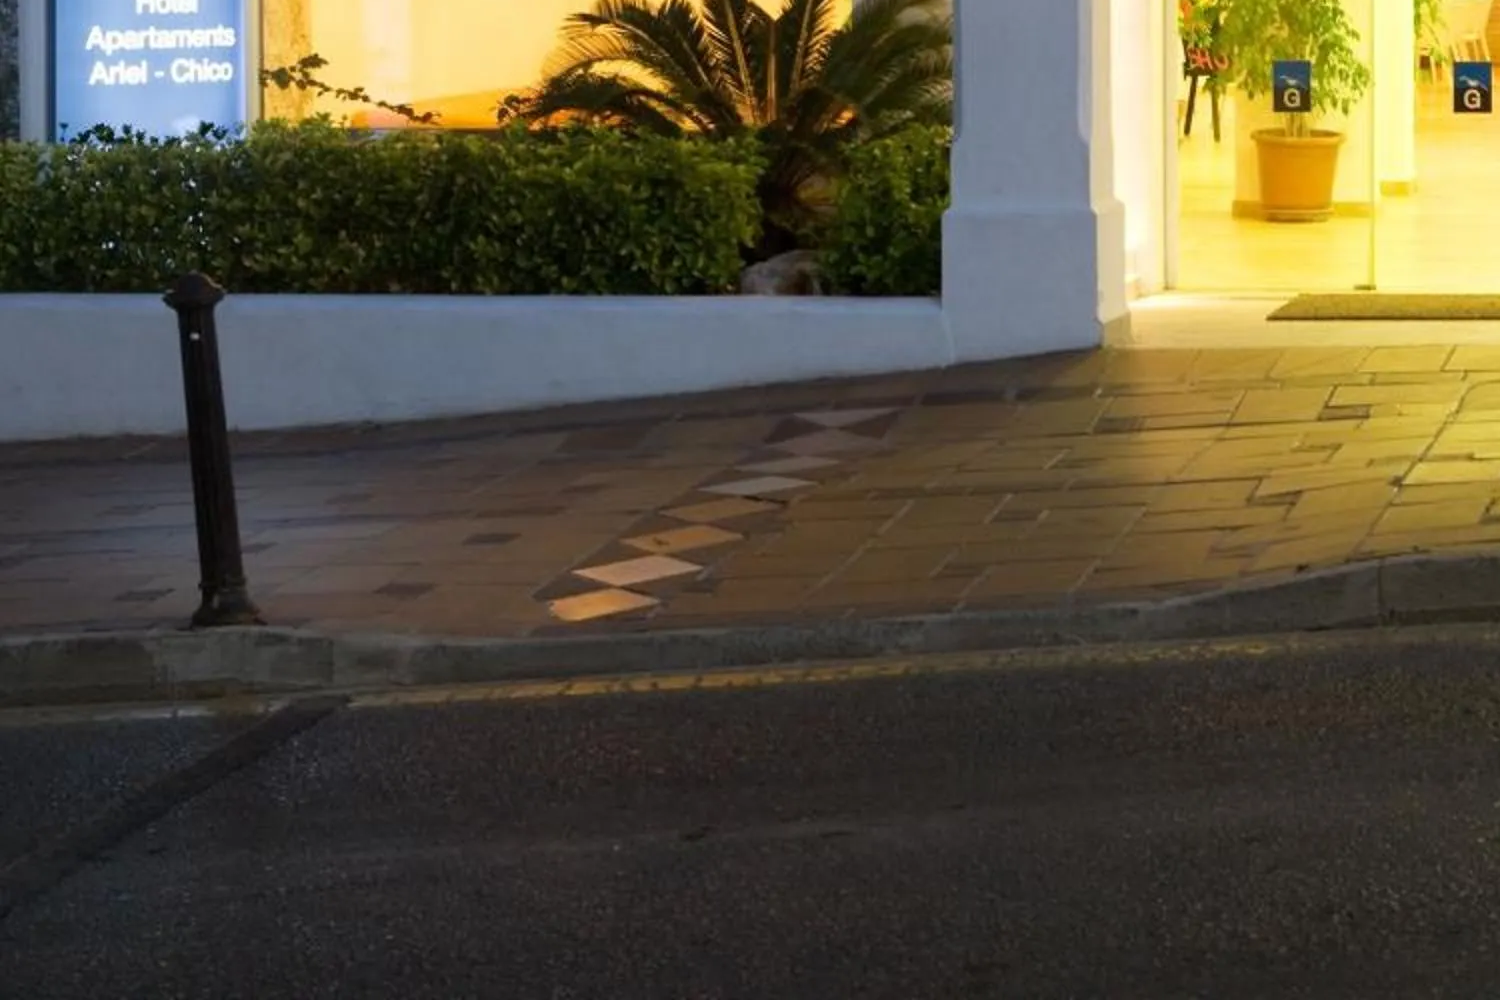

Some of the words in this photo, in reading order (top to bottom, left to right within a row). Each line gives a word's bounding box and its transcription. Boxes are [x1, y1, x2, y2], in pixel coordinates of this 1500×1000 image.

[85, 24, 236, 56] Apartaments
[88, 60, 148, 86] Ariel
[170, 57, 234, 84] Chico
[1283, 88, 1301, 108] G
[1464, 89, 1481, 109] G
